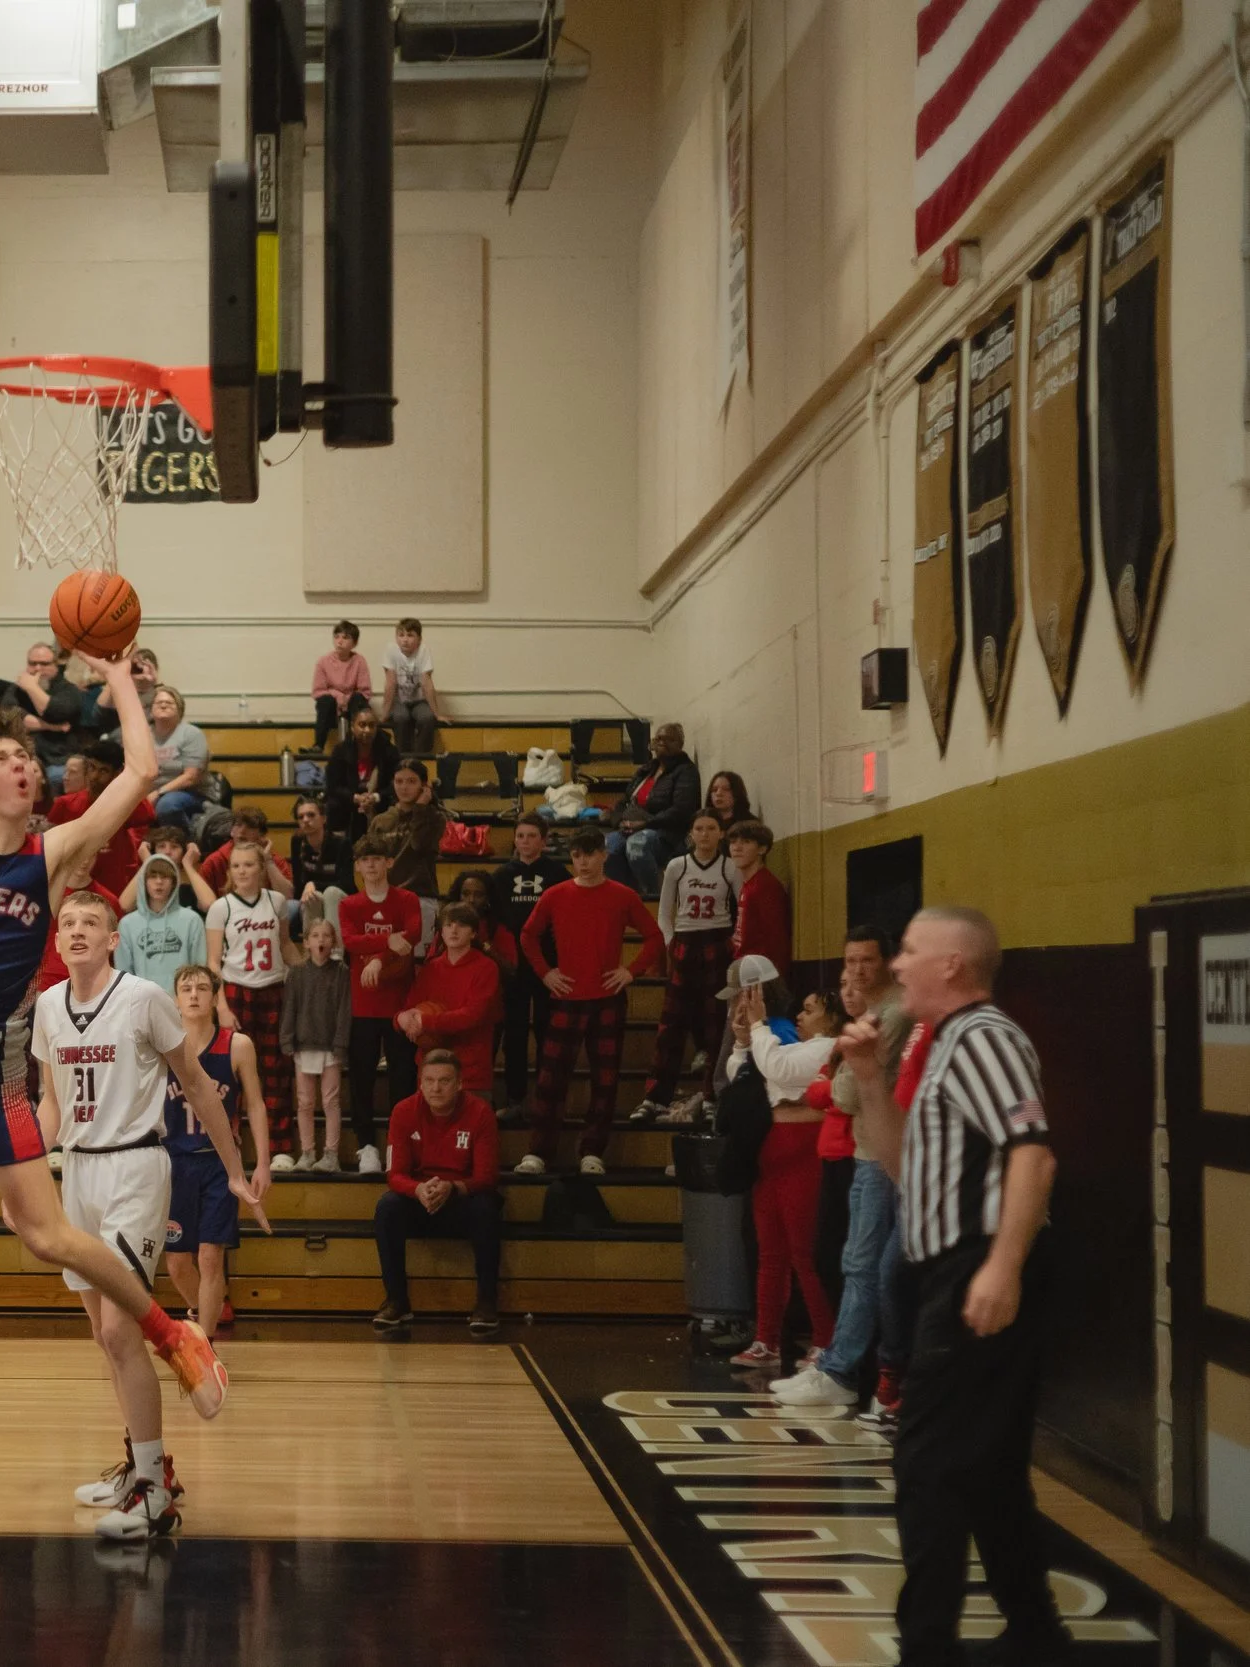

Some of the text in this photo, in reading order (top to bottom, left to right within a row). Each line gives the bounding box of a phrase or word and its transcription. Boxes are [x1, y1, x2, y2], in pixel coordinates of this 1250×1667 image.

[688, 879, 718, 890] Heat
[511, 895, 541, 903] FREEDO
[687, 895, 716, 919] 33
[234, 918, 276, 934] Heat
[244, 938, 273, 972] 13
[56, 1044, 117, 1065] TENNESSEE
[73, 1067, 96, 1102] 31
